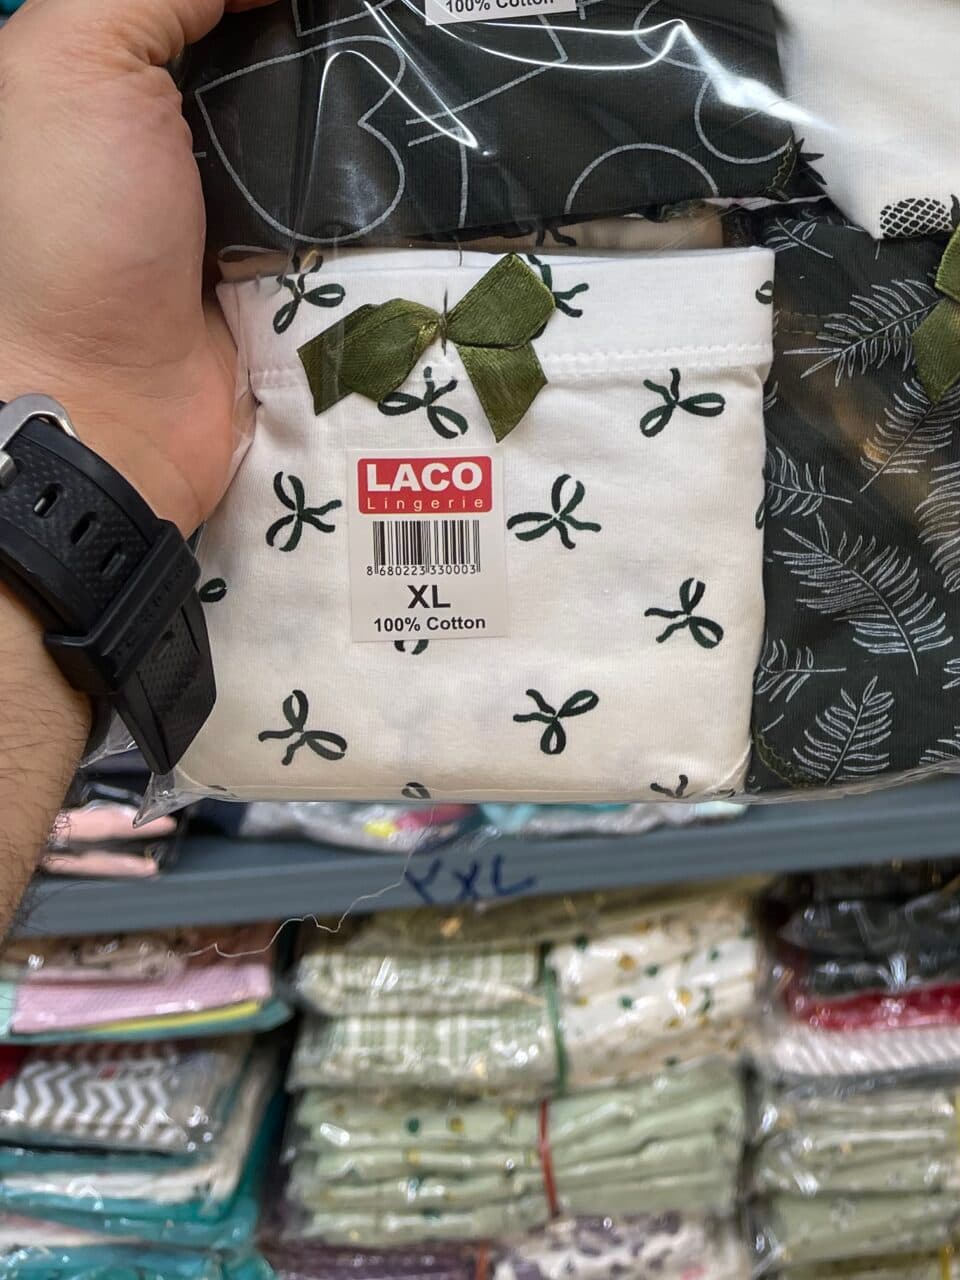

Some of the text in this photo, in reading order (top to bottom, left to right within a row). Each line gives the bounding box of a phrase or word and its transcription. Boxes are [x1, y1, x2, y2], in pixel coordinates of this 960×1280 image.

[366, 461, 483, 492] LACO
[367, 497, 484, 512] Lingerie
[407, 584, 452, 609] XL
[373, 615, 486, 633] 100% Cotton
